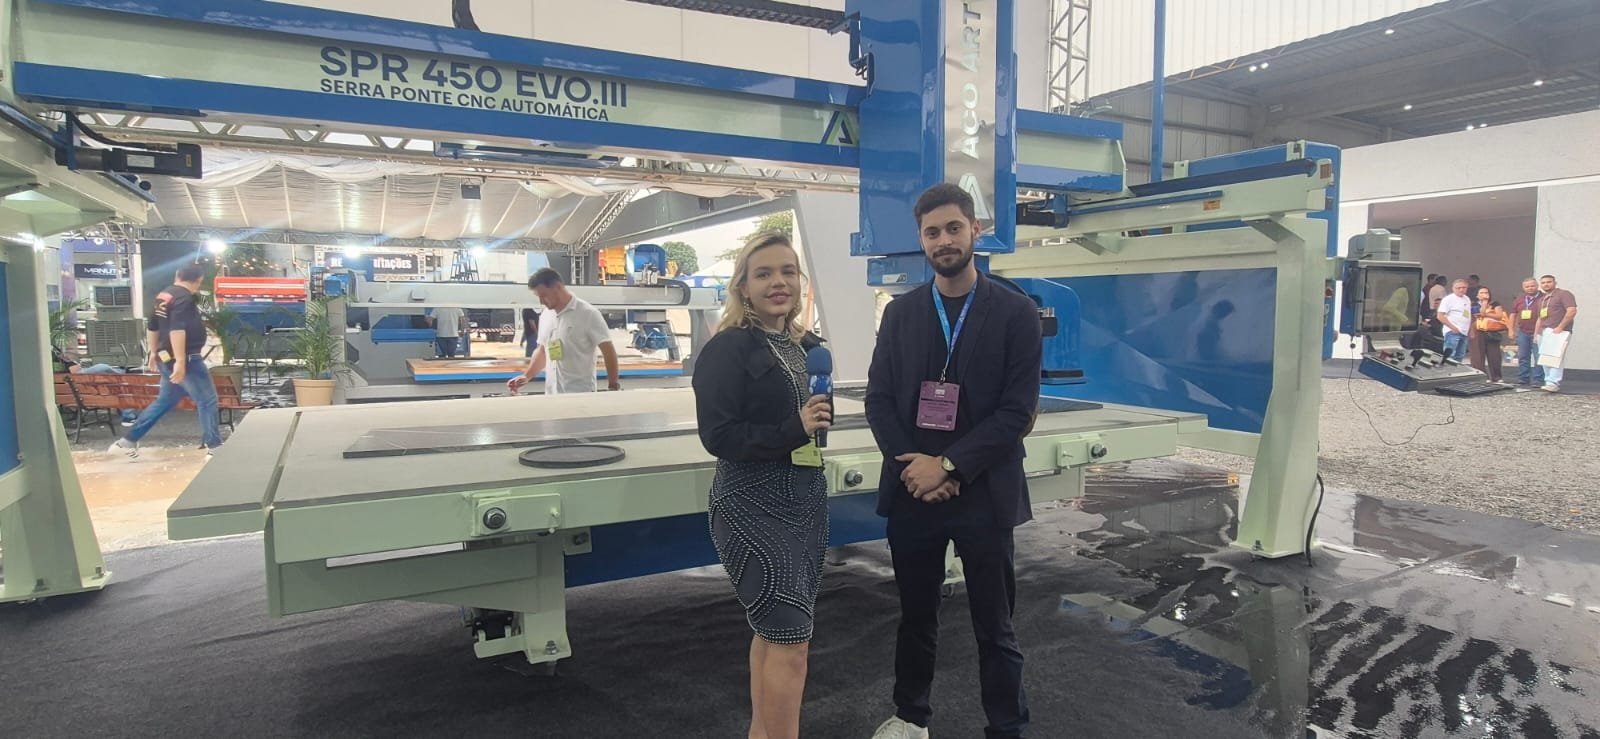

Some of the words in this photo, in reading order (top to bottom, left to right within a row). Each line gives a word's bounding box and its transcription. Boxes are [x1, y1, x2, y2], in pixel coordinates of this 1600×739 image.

[319, 46, 409, 84] SPR
[421, 58, 503, 94] 450
[516, 70, 628, 108] EVO.III
[320, 78, 386, 99] SERRA
[390, 85, 453, 105] PONTE
[457, 93, 497, 110] CNC
[500, 98, 610, 122] AUTOMÁTICA
[960, 82, 986, 160] AÇO
